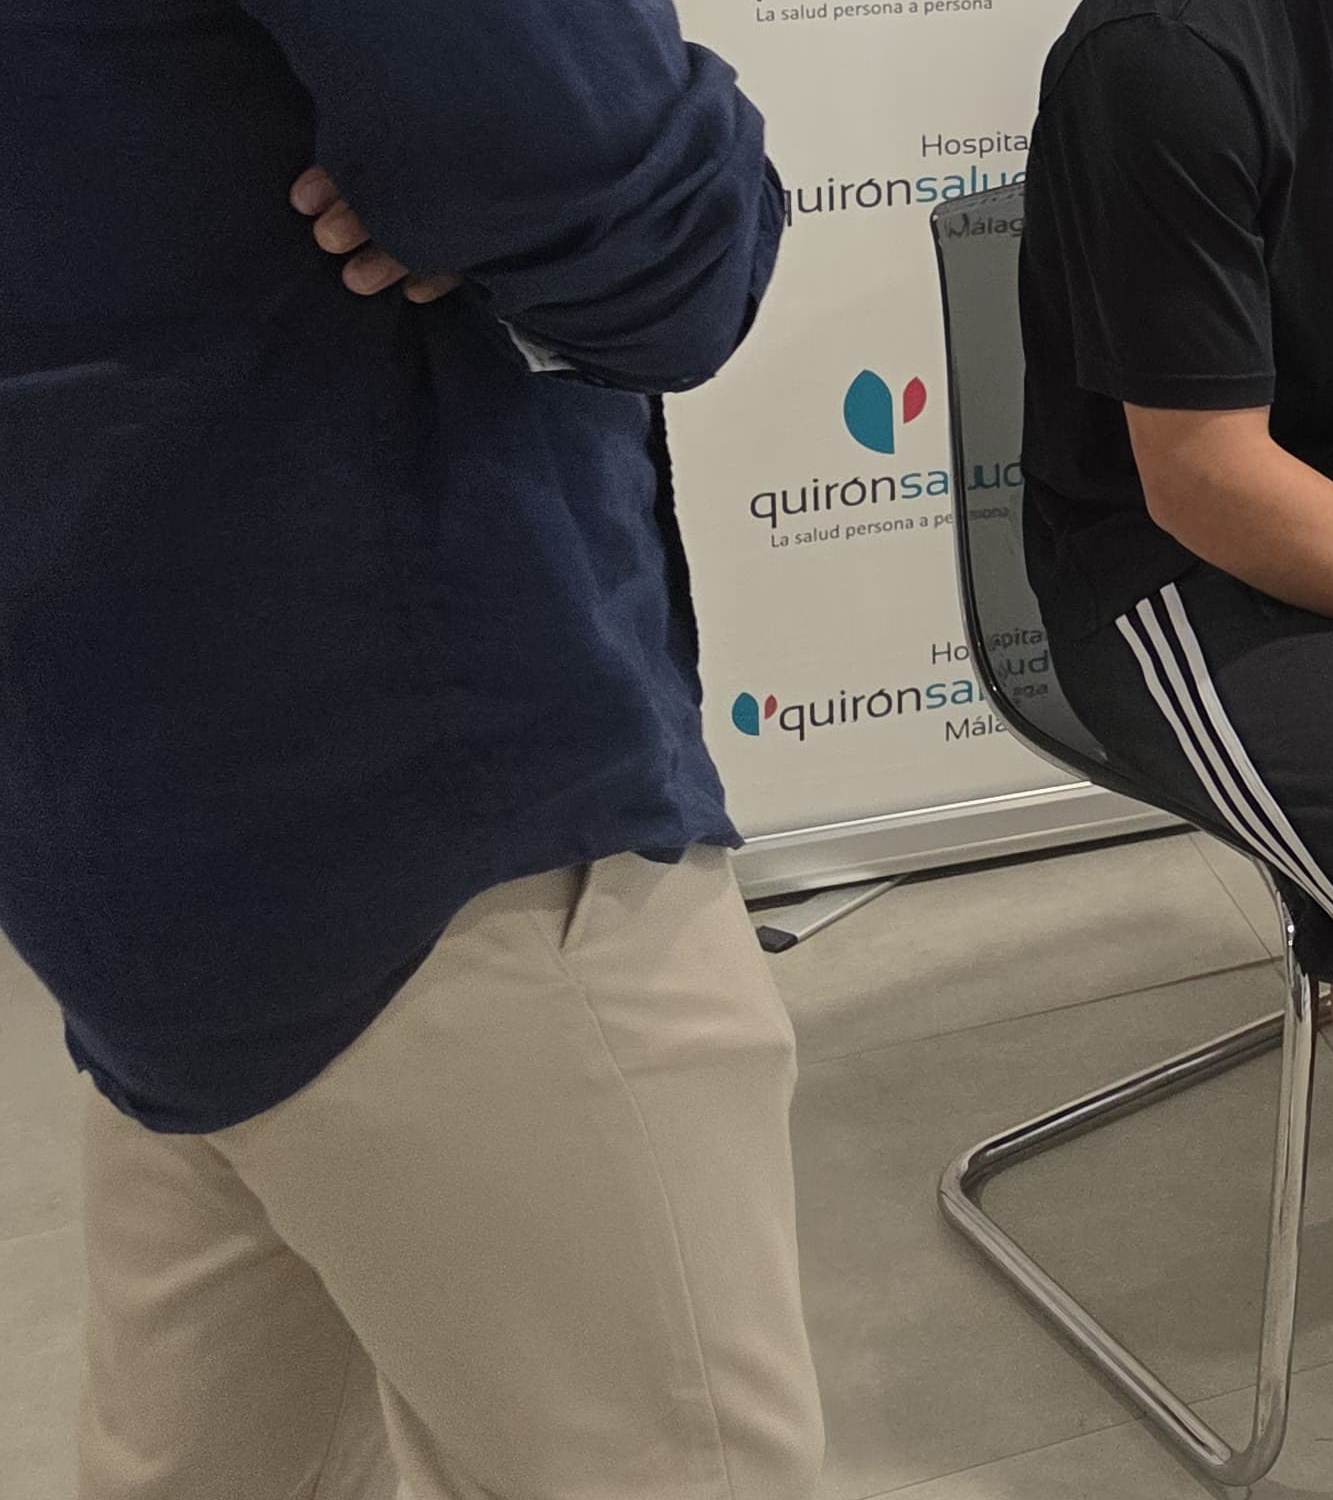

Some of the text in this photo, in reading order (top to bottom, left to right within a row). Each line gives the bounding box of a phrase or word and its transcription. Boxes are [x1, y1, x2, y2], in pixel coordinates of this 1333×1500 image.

[757, 0, 992, 22] La salud persona a persona
[922, 131, 1029, 159] Hospita
[944, 213, 1024, 237] Málag
[771, 534, 789, 548] La
[795, 525, 839, 545] salud
[846, 519, 913, 540] persona
[920, 517, 928, 527] a
